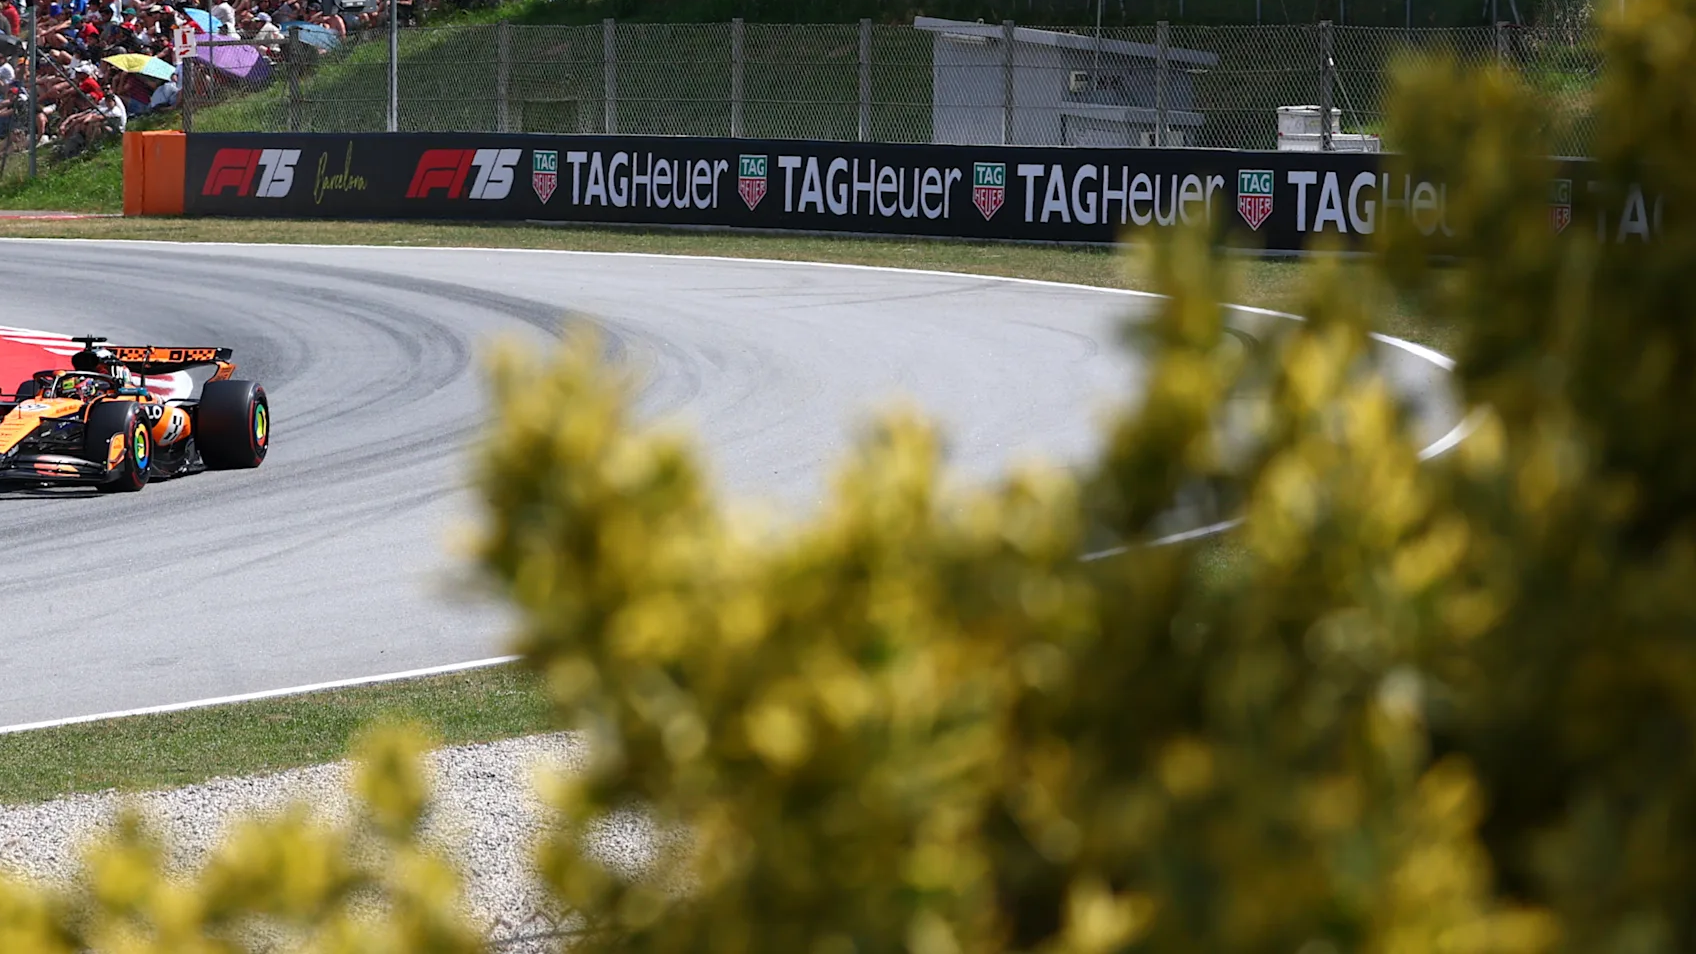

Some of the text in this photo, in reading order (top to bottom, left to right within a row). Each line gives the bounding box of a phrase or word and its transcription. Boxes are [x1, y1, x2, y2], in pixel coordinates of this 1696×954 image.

[314, 140, 368, 204] Barcelona
[535, 153, 556, 171] TAG
[741, 157, 766, 177] TAG
[976, 166, 1003, 185] TAG
[1241, 173, 1271, 193] TAG
[739, 179, 766, 208] HEUER
[974, 187, 1003, 217] HEUER
[1239, 197, 1272, 226] HEUER
